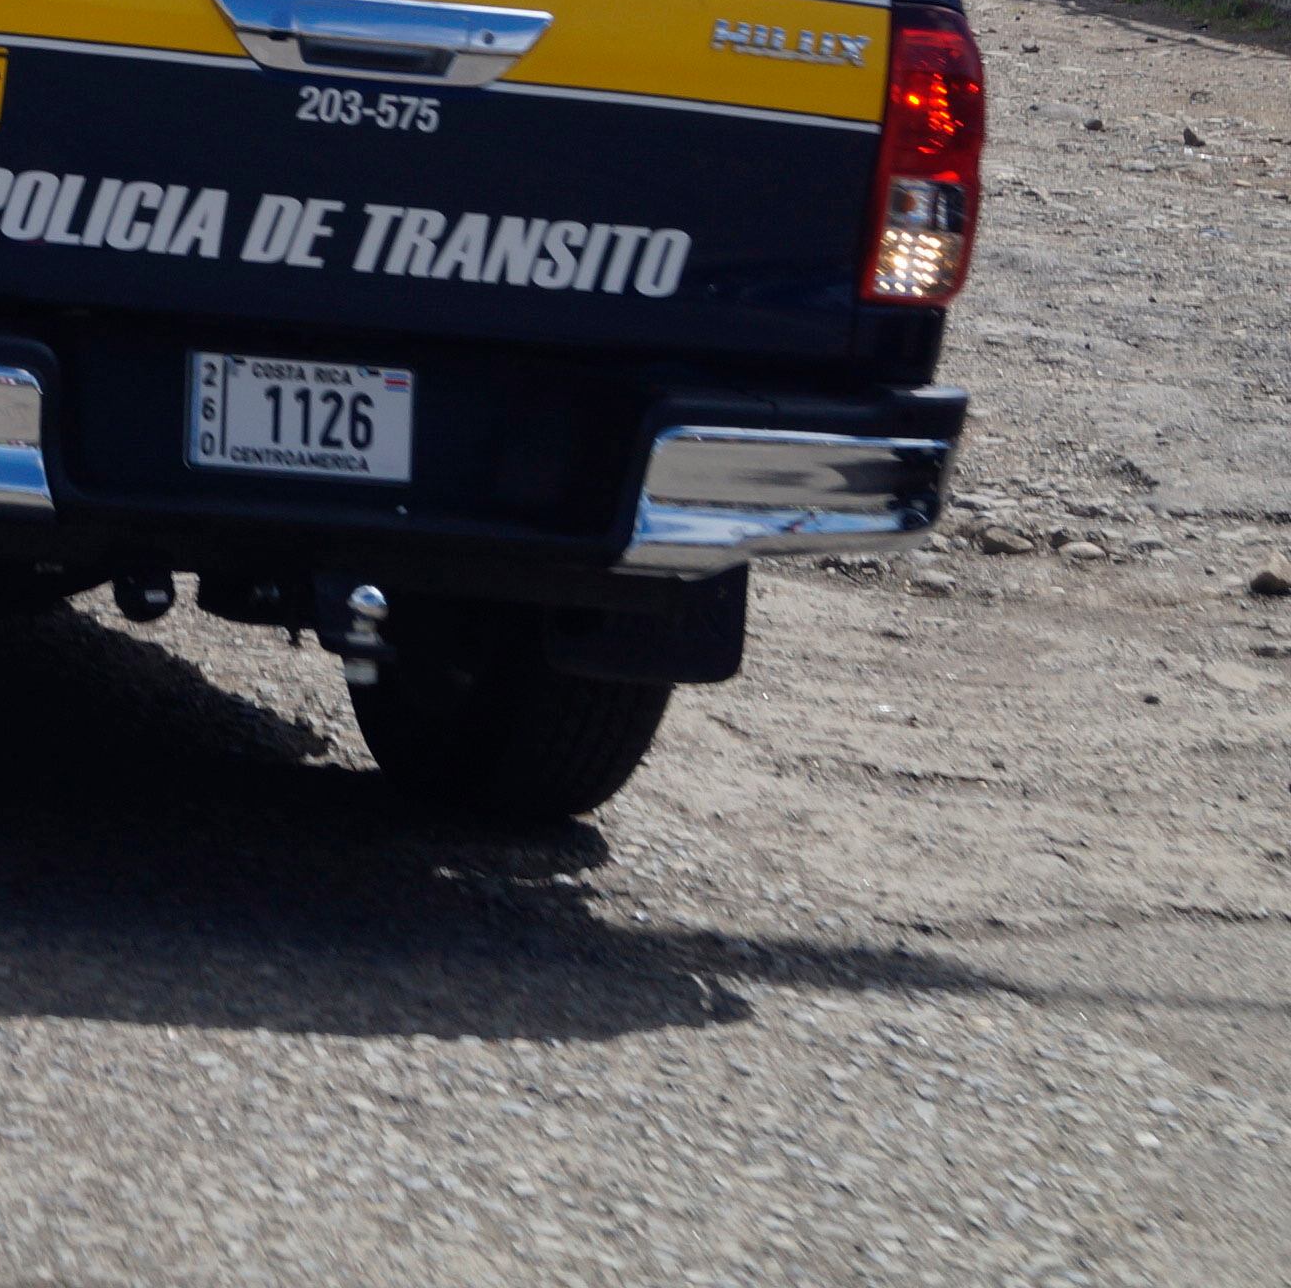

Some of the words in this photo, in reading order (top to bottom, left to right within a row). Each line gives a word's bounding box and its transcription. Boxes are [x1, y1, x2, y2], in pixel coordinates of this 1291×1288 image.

[296, 85, 440, 134] 203-575
[240, 192, 349, 270] DE
[352, 203, 692, 300] TRANSITO
[251, 363, 307, 383] COSTA
[314, 367, 353, 386] RICA
[265, 385, 375, 450] 1126
[230, 446, 371, 473] CENTROAMERICA
